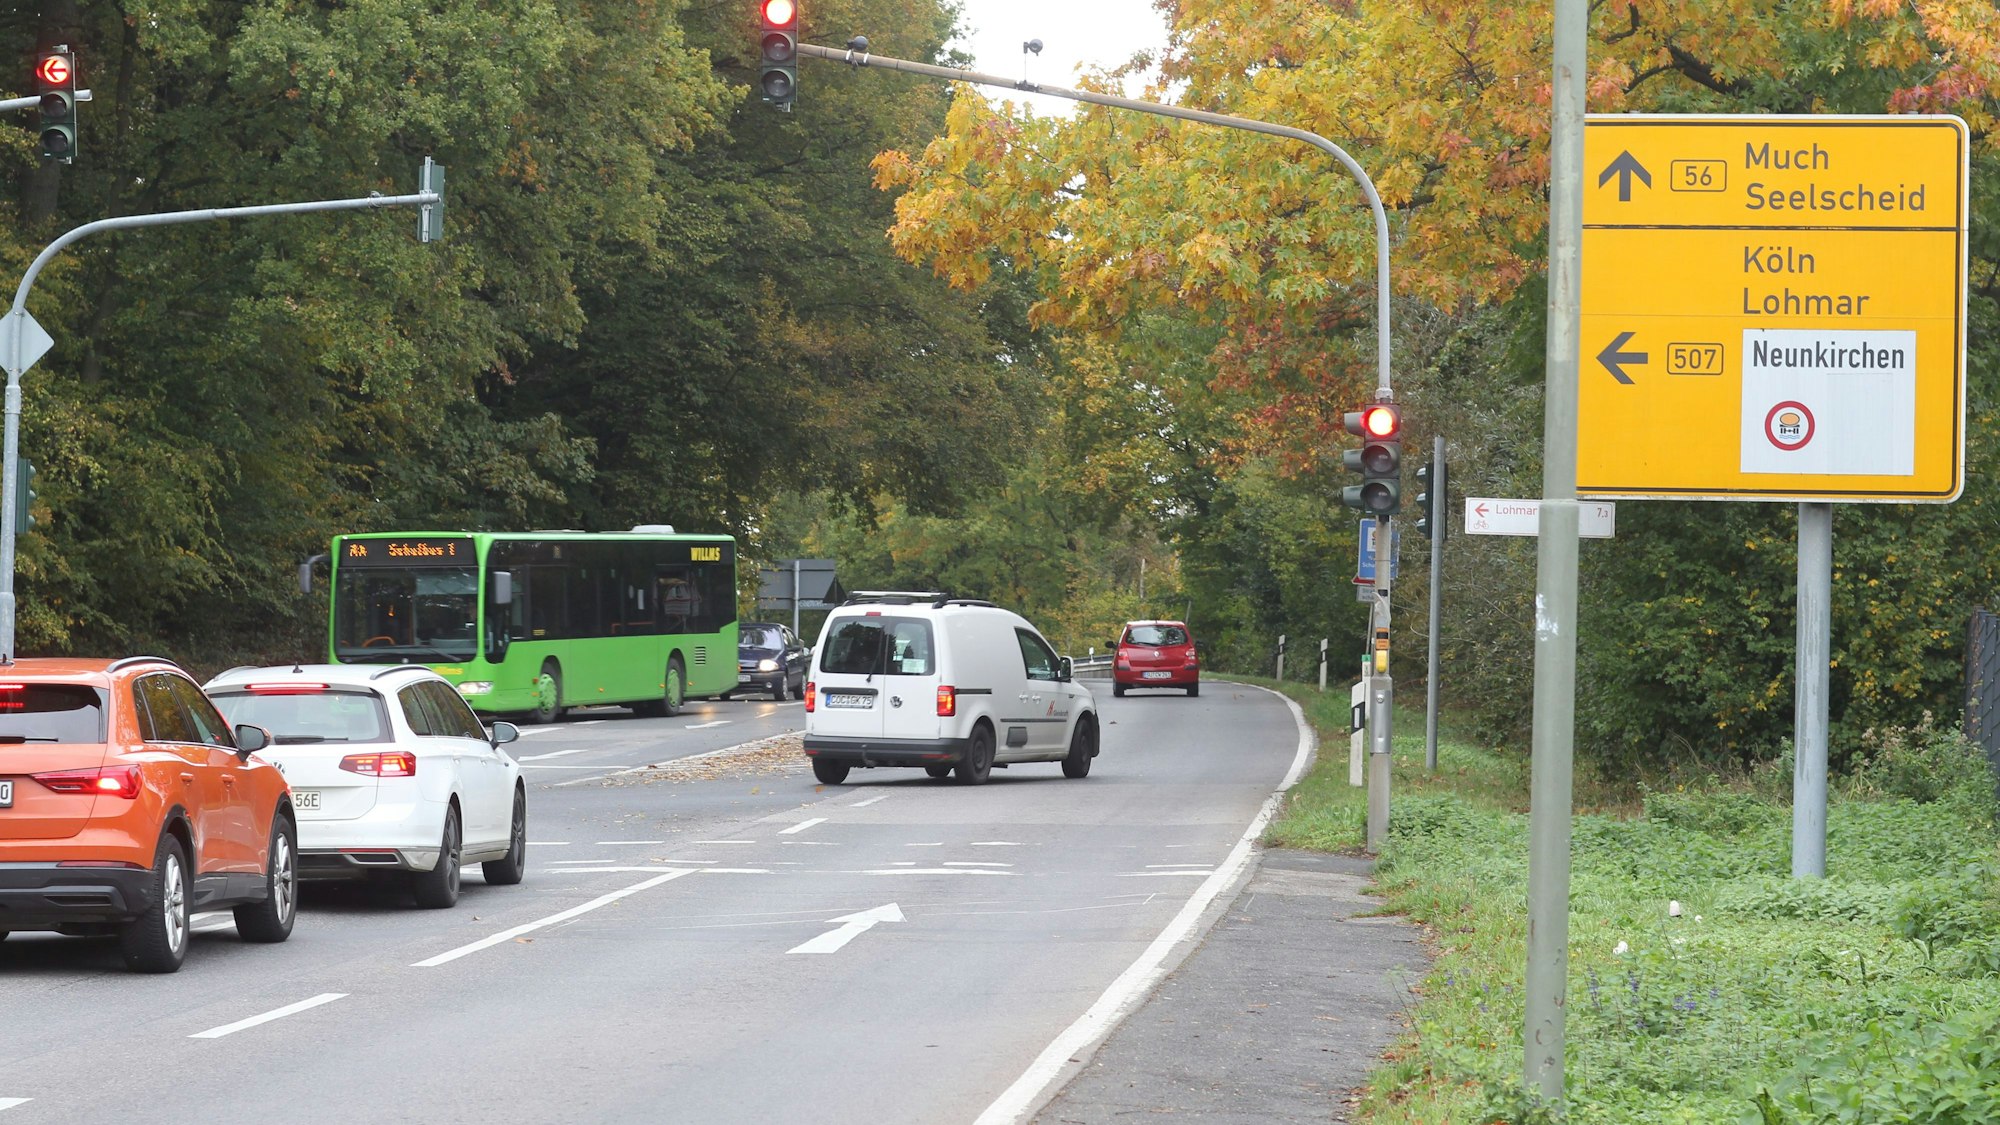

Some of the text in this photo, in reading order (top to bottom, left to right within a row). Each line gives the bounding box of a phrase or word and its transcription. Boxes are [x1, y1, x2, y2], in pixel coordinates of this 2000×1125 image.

[1745, 142, 1829, 170] Much
[1685, 165, 1713, 186] 56
[1745, 182, 1925, 211] Seelscheid
[1744, 246, 1815, 274] Köln
[1743, 287, 1870, 316] Lohmar
[1674, 348, 1717, 370] 507
[1753, 340, 1904, 369] Neunkirchen
[1495, 504, 1609, 518] Lohmar 7.3
[690, 547, 720, 561] WILLMS
